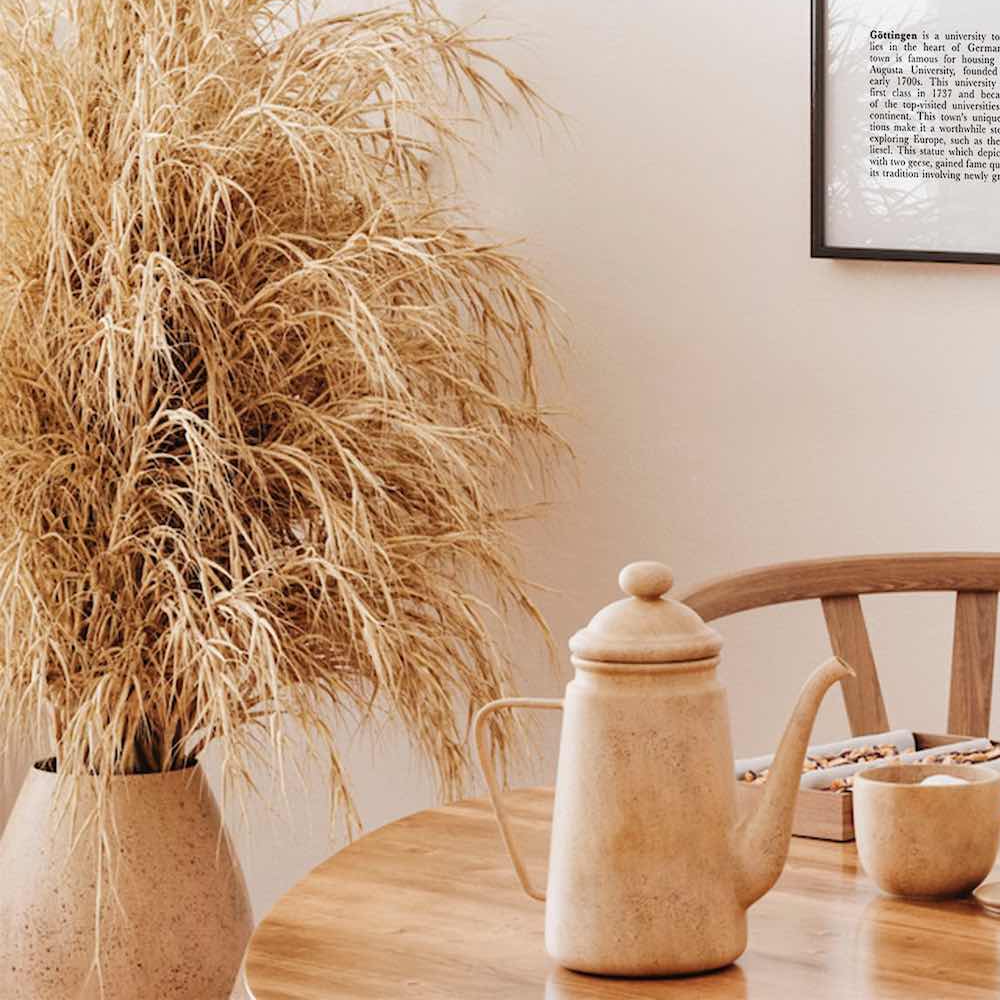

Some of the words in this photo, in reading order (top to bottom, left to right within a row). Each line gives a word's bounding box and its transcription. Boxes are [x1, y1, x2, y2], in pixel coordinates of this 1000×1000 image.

[944, 31, 986, 42] university
[869, 42, 883, 50] lies
[923, 42, 945, 51] heart
[908, 54, 938, 63] famous
[961, 54, 995, 66] housing
[869, 65, 903, 76] Augusta
[963, 66, 998, 75] founded
[869, 76, 890, 87] early
[897, 76, 923, 86] 1700s.
[930, 77, 949, 86] This
[954, 77, 996, 89] university
[869, 88, 886, 97] first
[892, 88, 911, 97] class
[932, 89, 951, 98] 1737
[902, 100, 947, 111] top-visited
[952, 101, 1000, 110] universities
[917, 112, 936, 121] This
[869, 122, 890, 131] tions
[893, 123, 916, 132] make
[938, 124, 986, 133] worthwhile
[869, 134, 909, 145] exploring
[950, 135, 970, 144] such
[897, 146, 916, 155] This
[919, 147, 945, 156] statue
[948, 147, 974, 156] which
[869, 157, 888, 166] with
[935, 158, 964, 170] gained
[966, 159, 987, 168] fame
[882, 168, 919, 178] tradition
[922, 170, 961, 181] involving
[964, 171, 989, 182] newly
